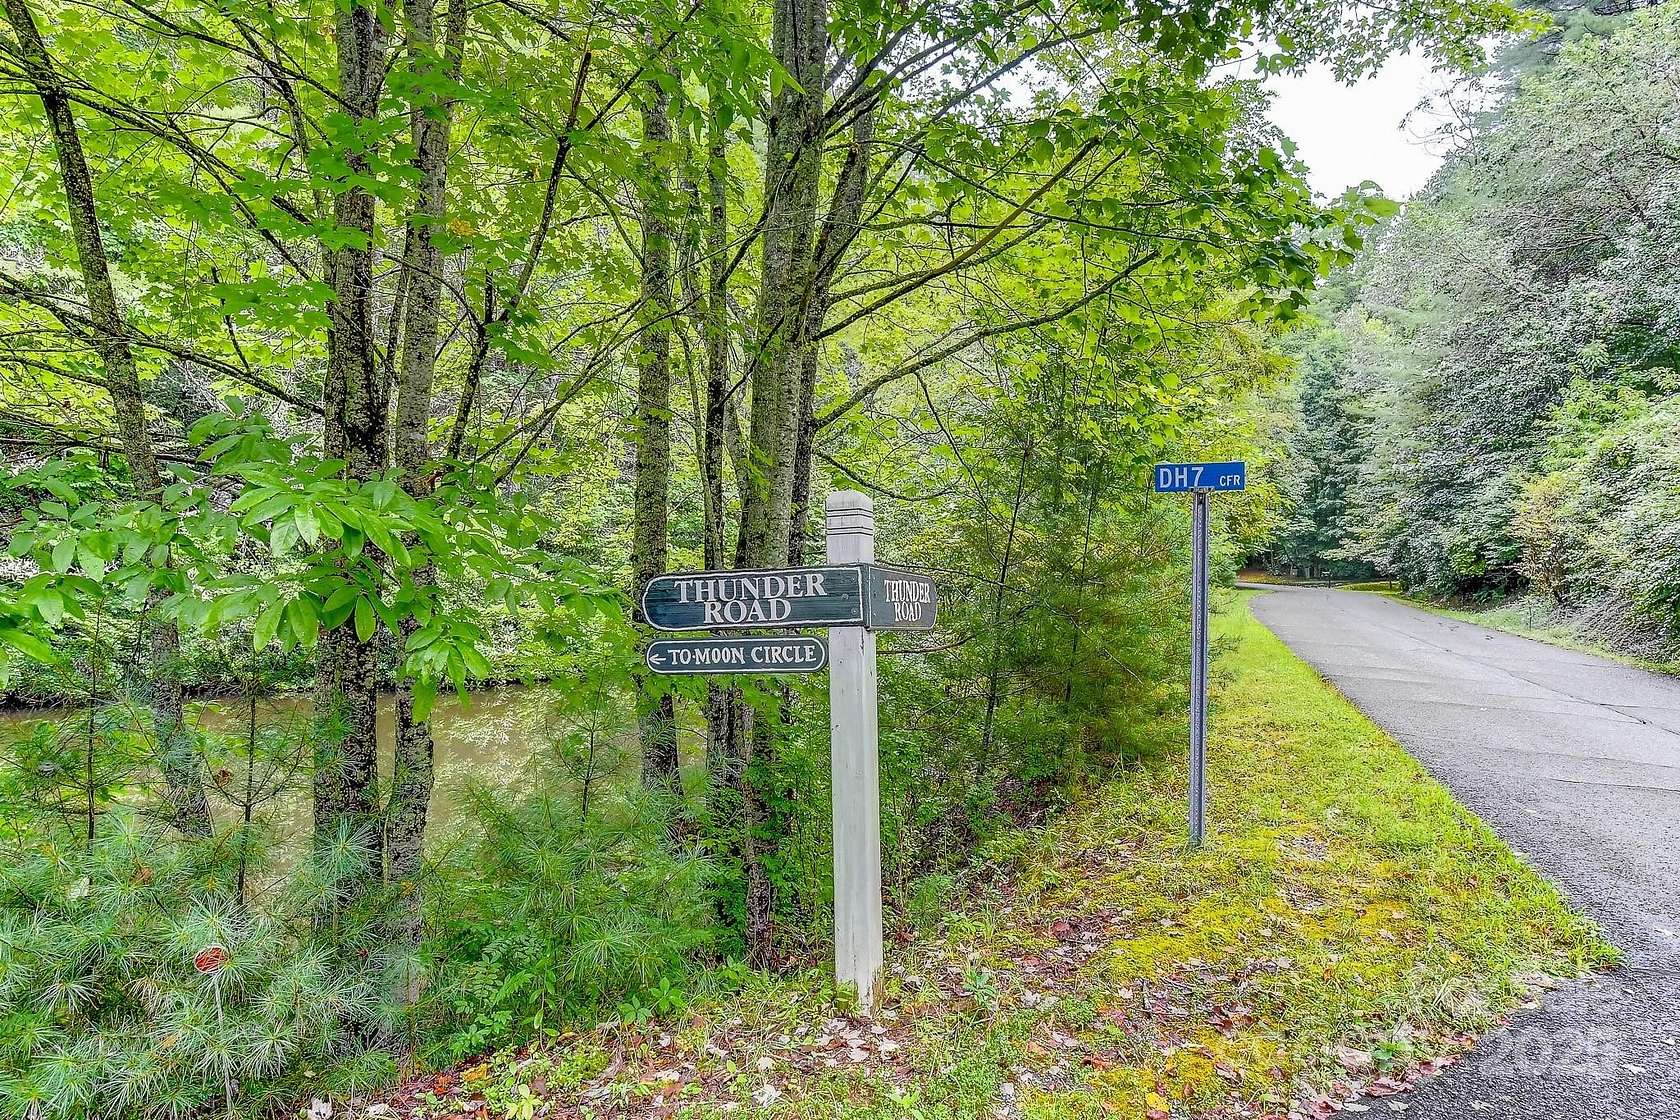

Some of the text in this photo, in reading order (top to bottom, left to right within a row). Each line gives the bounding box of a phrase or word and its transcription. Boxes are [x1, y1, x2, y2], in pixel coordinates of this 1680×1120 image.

[1159, 466, 1241, 488] DH7 CFR
[673, 573, 828, 604] THUNDER
[884, 579, 931, 603] THUNDER
[703, 598, 792, 625] ROAD
[894, 601, 922, 623] ROAD
[750, 644, 817, 664] CIRCLE
